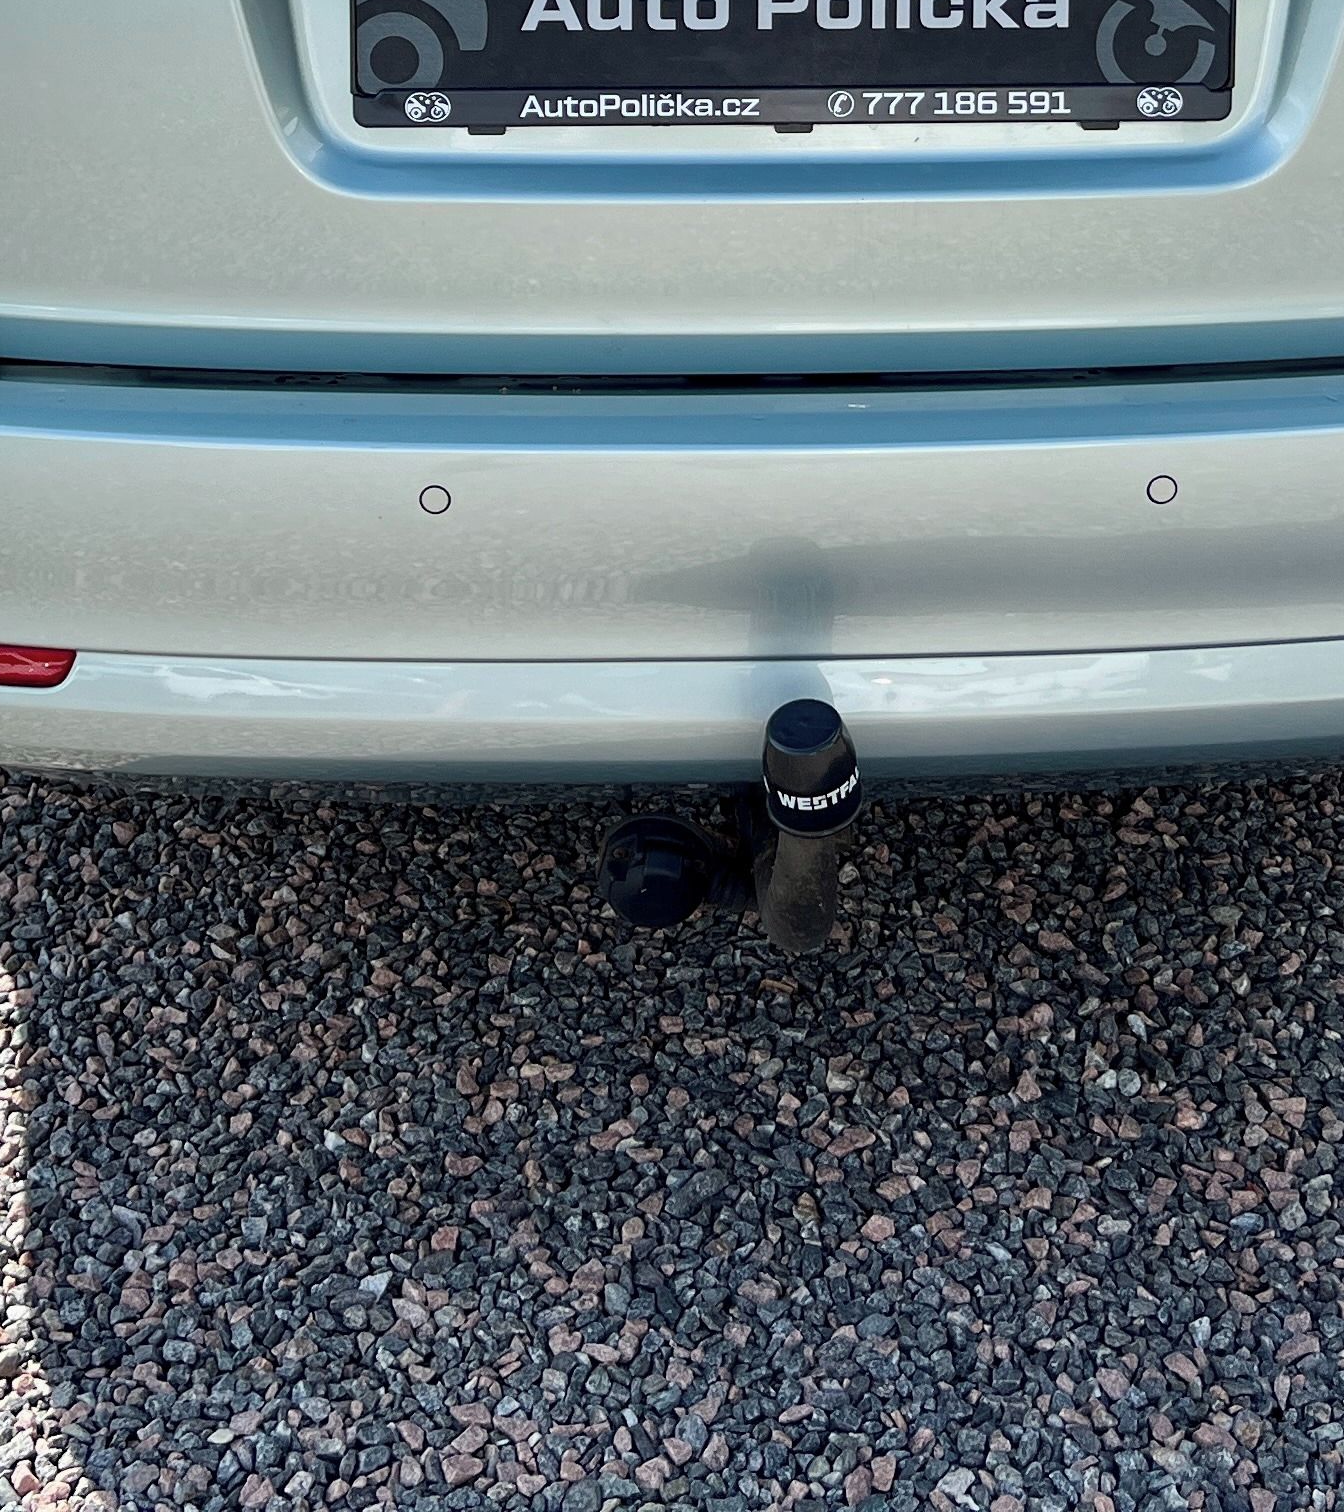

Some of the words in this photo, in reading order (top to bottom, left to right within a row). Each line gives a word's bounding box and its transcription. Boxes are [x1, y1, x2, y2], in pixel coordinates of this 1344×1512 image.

[519, 93, 760, 118] AutoPolička.cz
[862, 92, 926, 116] 777
[933, 91, 998, 115] 186
[1007, 90, 1072, 115] 591
